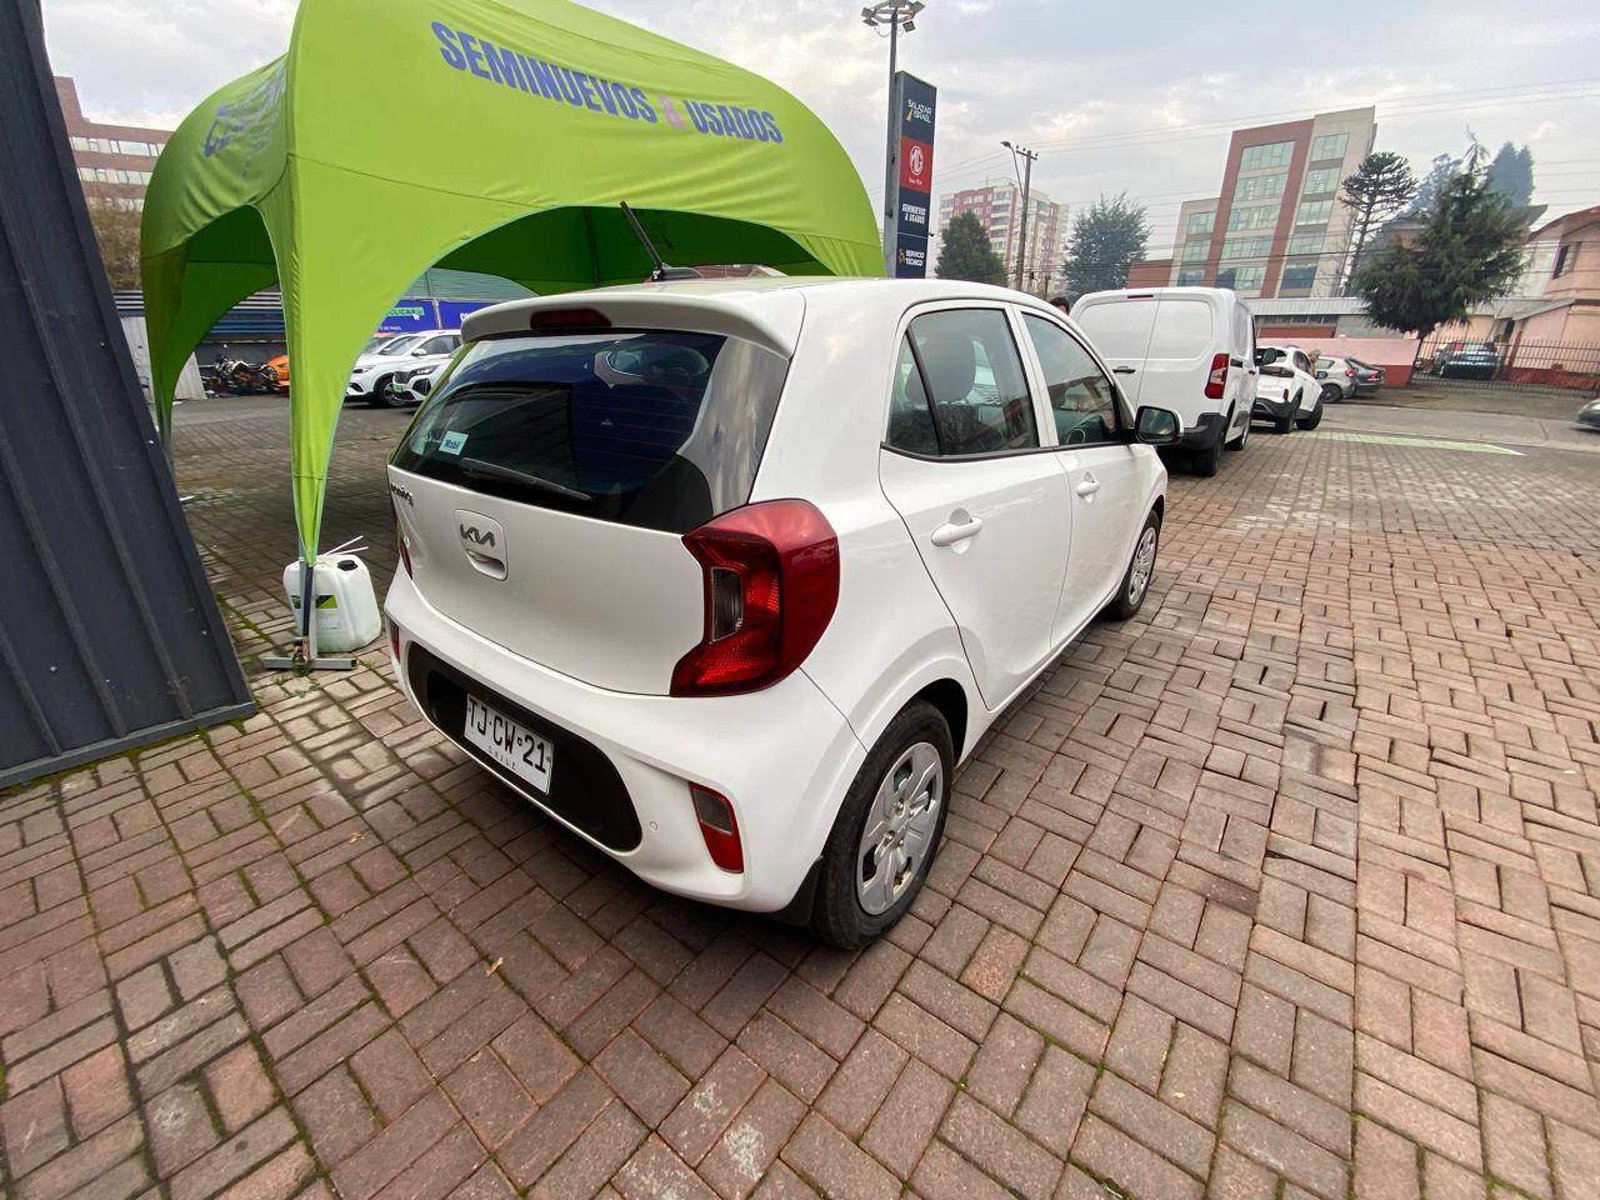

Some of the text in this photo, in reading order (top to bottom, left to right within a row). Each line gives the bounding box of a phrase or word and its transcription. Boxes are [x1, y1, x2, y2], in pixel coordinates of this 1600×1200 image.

[431, 21, 658, 124] SEMINUEVOS
[683, 100, 784, 144] USADOS
[907, 99, 932, 115] SALAZAR
[912, 110, 931, 124] ISRAEL
[459, 523, 496, 548] KIA
